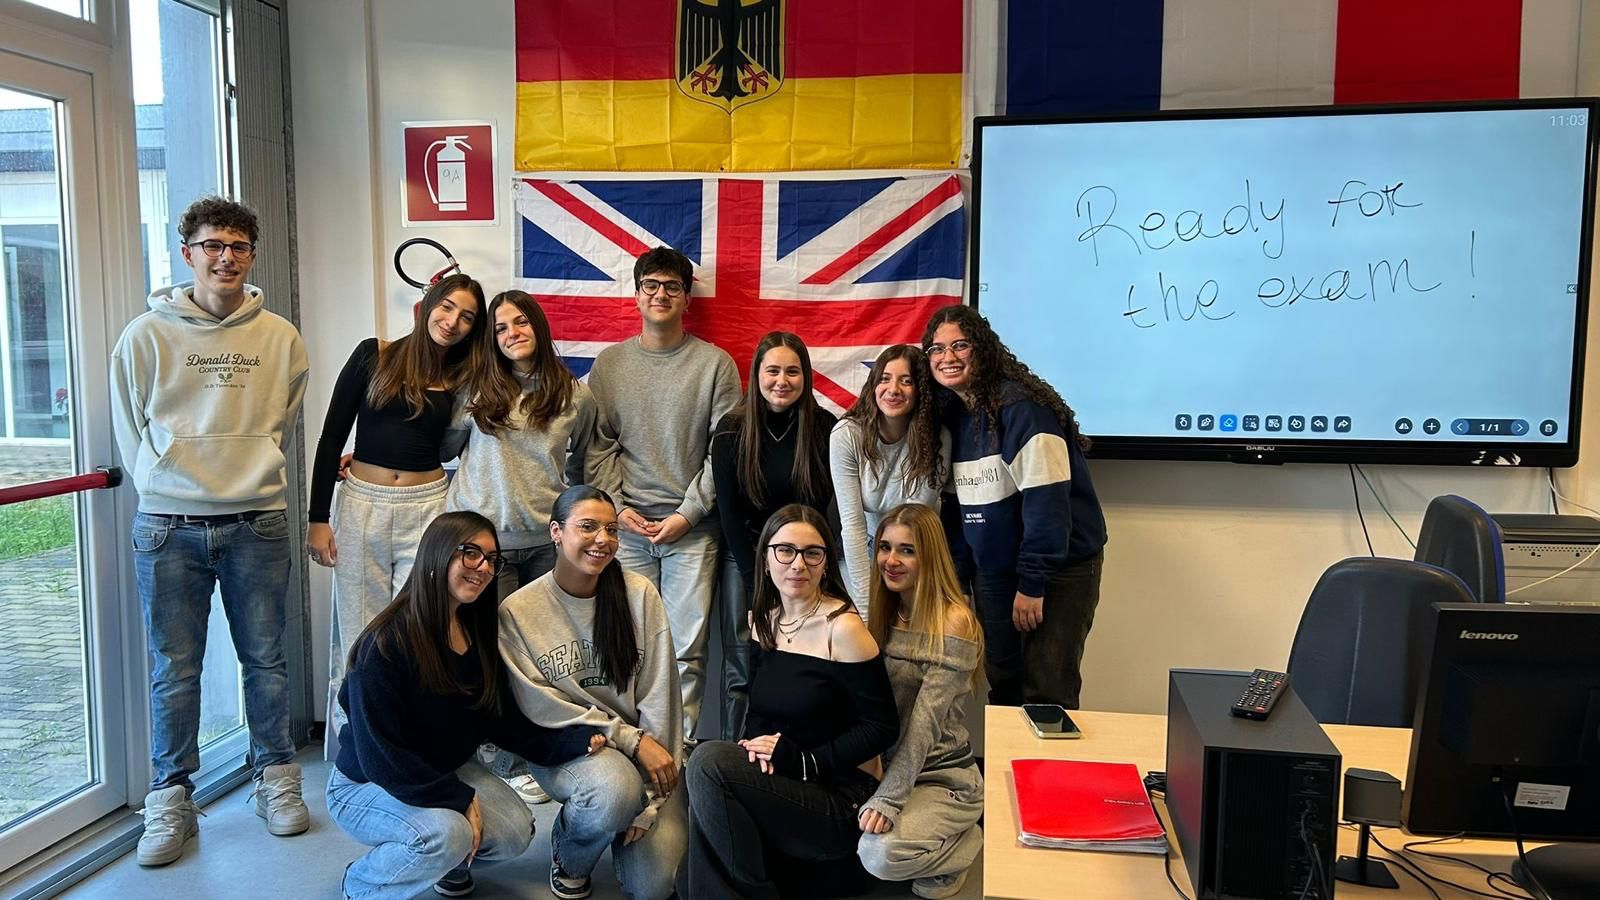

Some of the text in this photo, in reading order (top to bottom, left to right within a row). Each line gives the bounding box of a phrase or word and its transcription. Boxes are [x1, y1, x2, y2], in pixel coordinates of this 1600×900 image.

[1550, 114, 1586, 127] 11:03
[1076, 178, 1424, 267] Ready for
[1123, 271, 1236, 329] the
[185, 352, 261, 367] Donald Duck
[198, 366, 251, 374] COUNTRY CLUB
[1479, 423, 1500, 432] 1/1
[1459, 629, 1519, 641] lenovo
[583, 677, 606, 687] 1994
